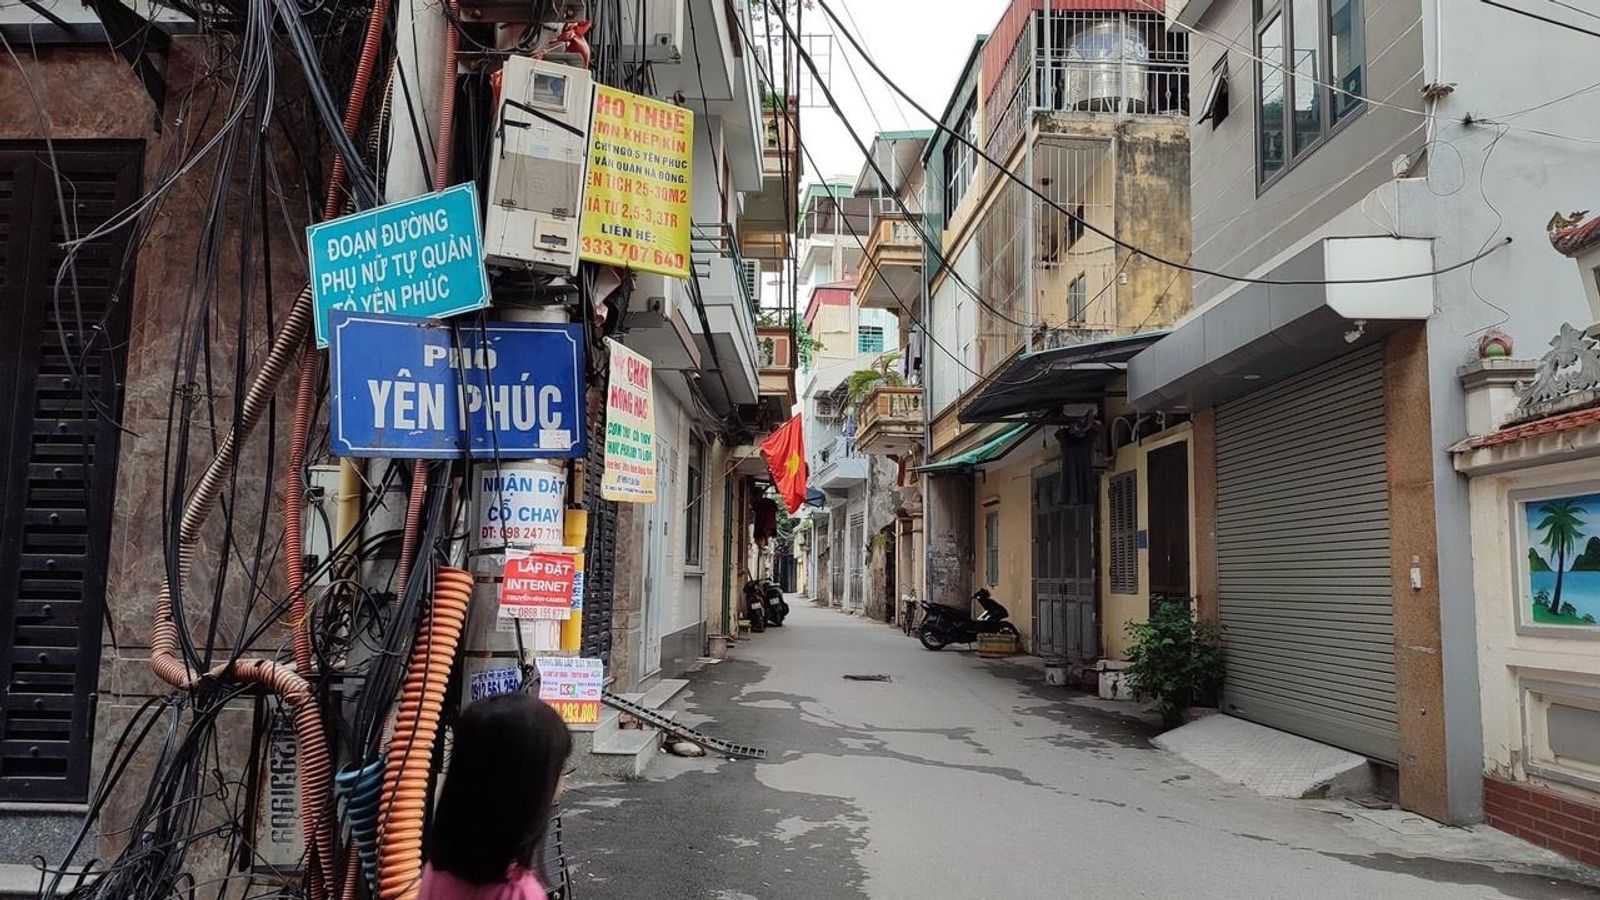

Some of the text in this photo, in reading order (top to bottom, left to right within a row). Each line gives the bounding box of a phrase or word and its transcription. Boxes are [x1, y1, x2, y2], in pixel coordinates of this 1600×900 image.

[594, 121, 620, 138] MN
[633, 102, 685, 134] THUÊ
[634, 151, 641, 159] 5
[327, 208, 449, 261] ĐOẠN ĐƯỜNG
[601, 223, 632, 238] LIÊN
[321, 234, 473, 296] PHỤ NỮ TỰ QUẢN
[619, 242, 649, 263] 707
[654, 250, 684, 269] 640
[361, 286, 397, 314] YÊN
[401, 271, 450, 308] PHÚC
[423, 337, 502, 370] PHỐ
[367, 368, 562, 431] YÊN PHÚC
[483, 473, 565, 499] NHẬN ĐẶT
[488, 498, 559, 523] CỖ CHAY
[482, 526, 497, 539] ĐT:
[500, 527, 520, 539] 098
[524, 527, 543, 540] 247
[518, 557, 571, 577] LẮP ĐẶT
[507, 578, 569, 593] INTERNET
